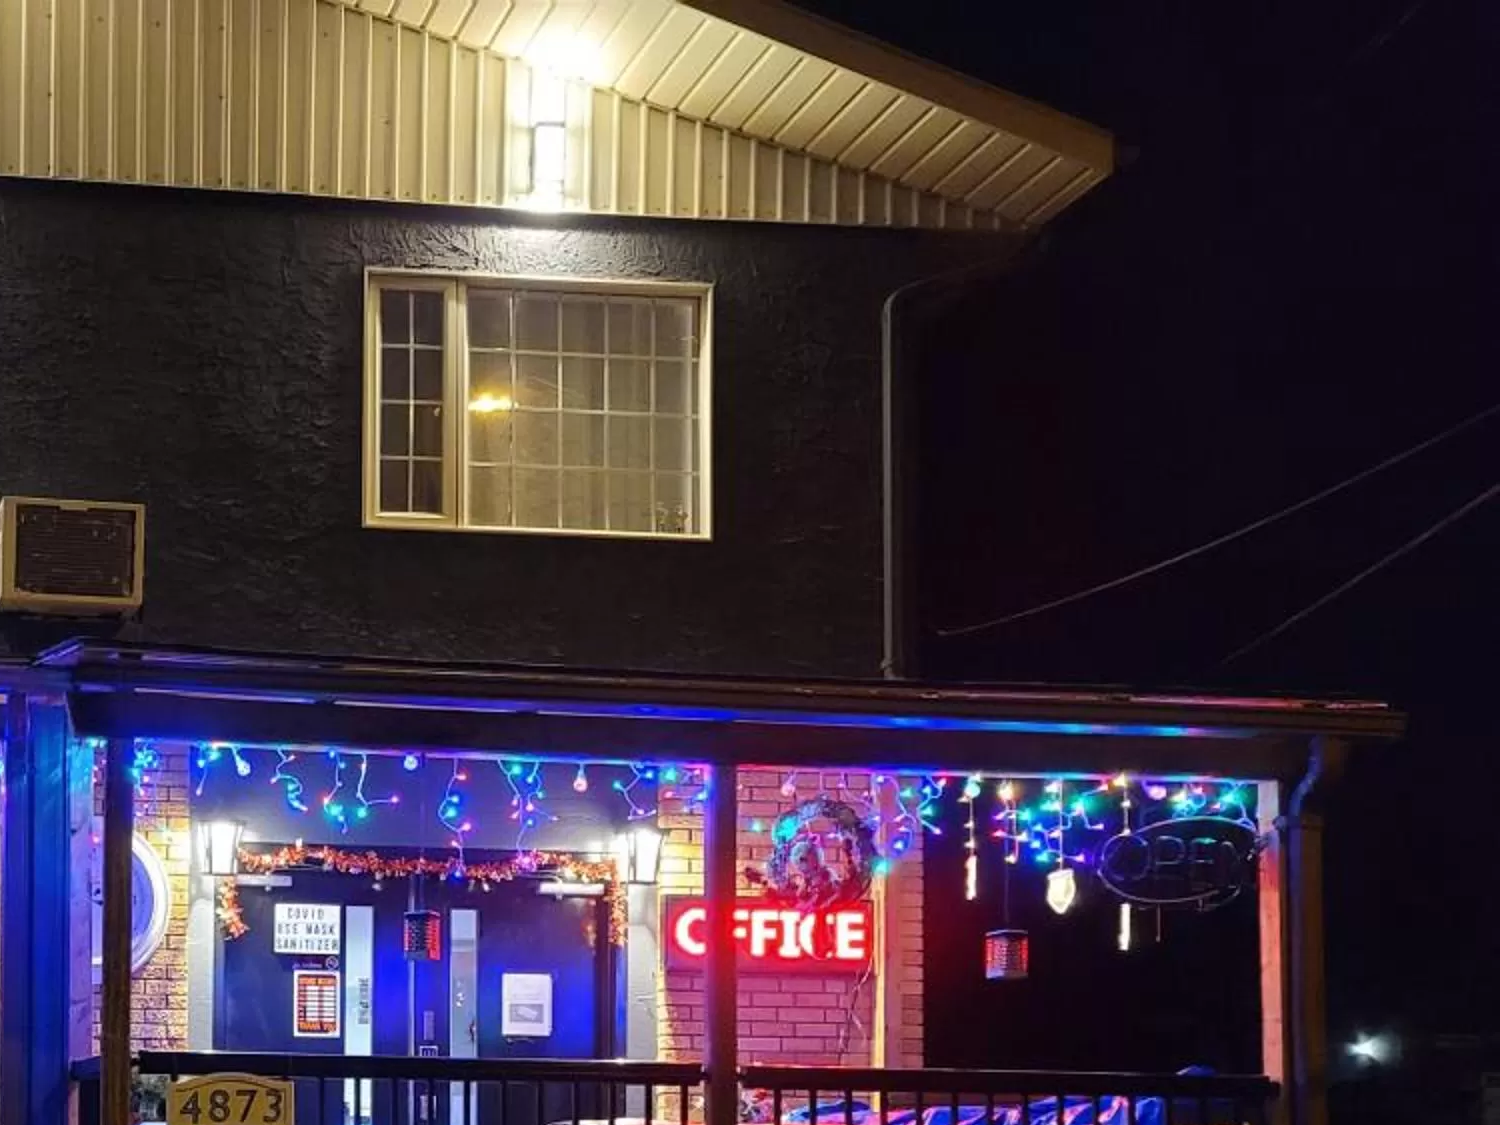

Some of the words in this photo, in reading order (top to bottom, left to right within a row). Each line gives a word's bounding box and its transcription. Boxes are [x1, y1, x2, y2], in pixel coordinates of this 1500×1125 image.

[287, 907, 325, 920] COVID
[277, 923, 299, 935] USE
[305, 923, 337, 936] MASK
[276, 938, 339, 951] SANITIZER
[179, 1088, 283, 1125] 4873
